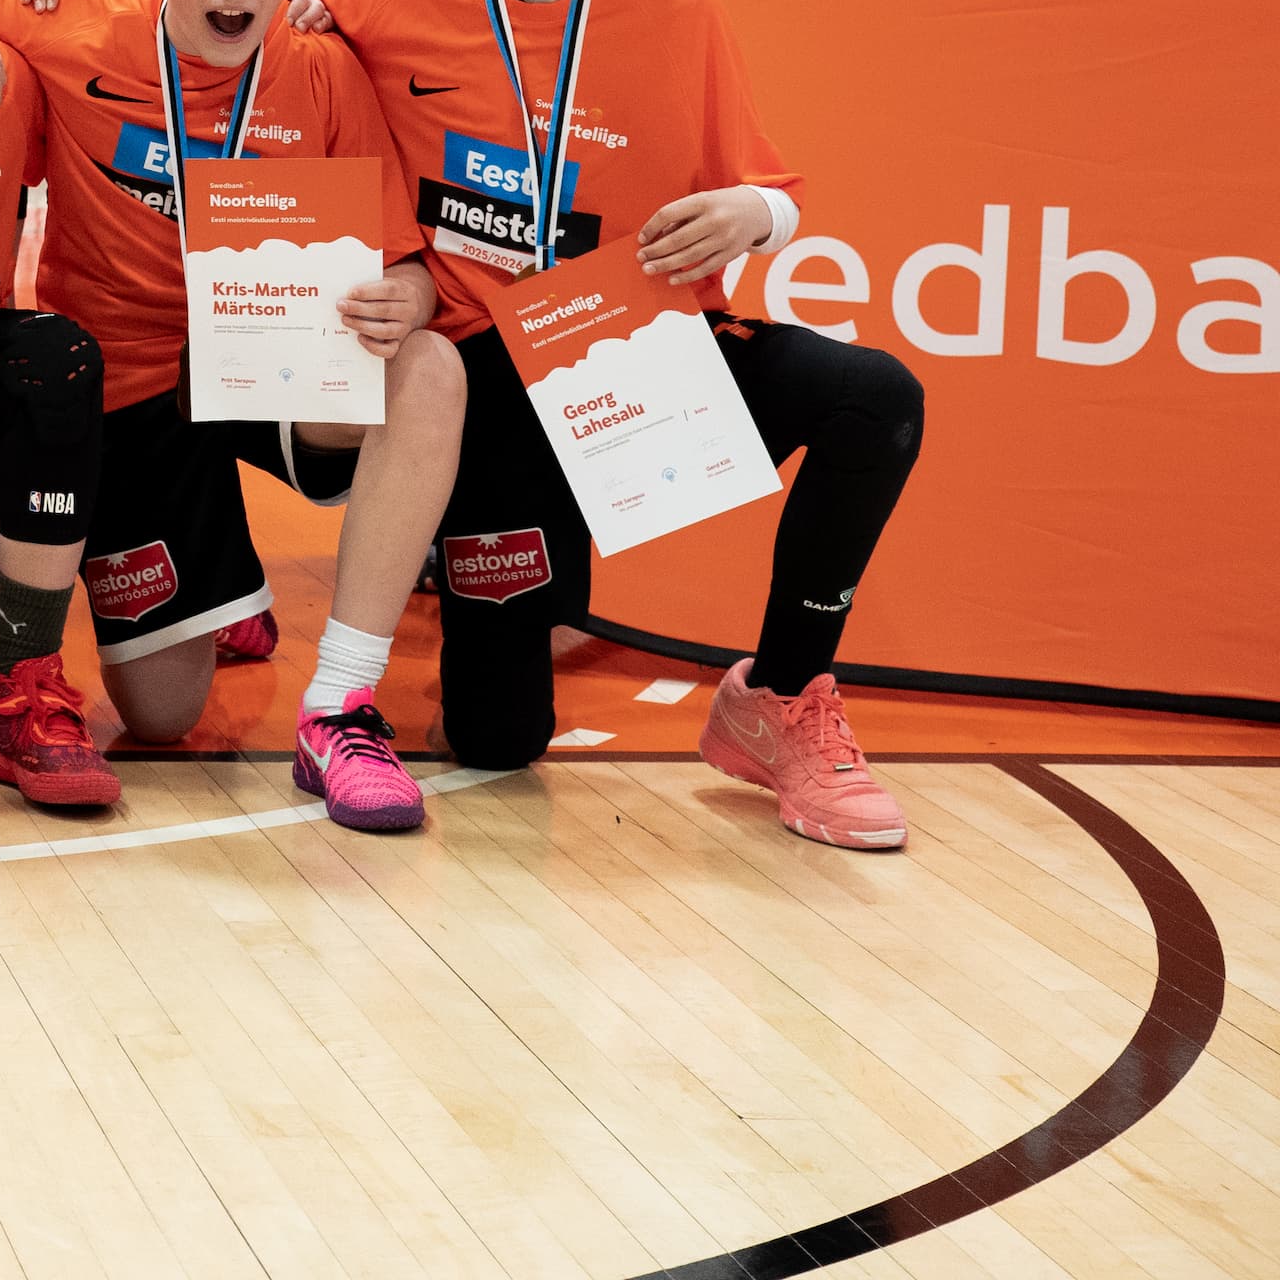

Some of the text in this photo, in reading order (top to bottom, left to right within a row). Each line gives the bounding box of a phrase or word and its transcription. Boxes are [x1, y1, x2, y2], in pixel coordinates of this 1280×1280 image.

[465, 150, 536, 197] Eest
[209, 193, 297, 211] Noorteliiga
[462, 243, 524, 271] 2025/2026
[212, 281, 319, 298] Kris-Marten
[723, 205, 1280, 374] edba
[212, 300, 286, 316] Märtson
[521, 293, 603, 334] Noorteliiga
[562, 391, 617, 420] Georg
[571, 400, 645, 441] Lahesalu
[42, 492, 75, 515] NBA
[452, 550, 538, 573] estover
[92, 562, 164, 595] estover
